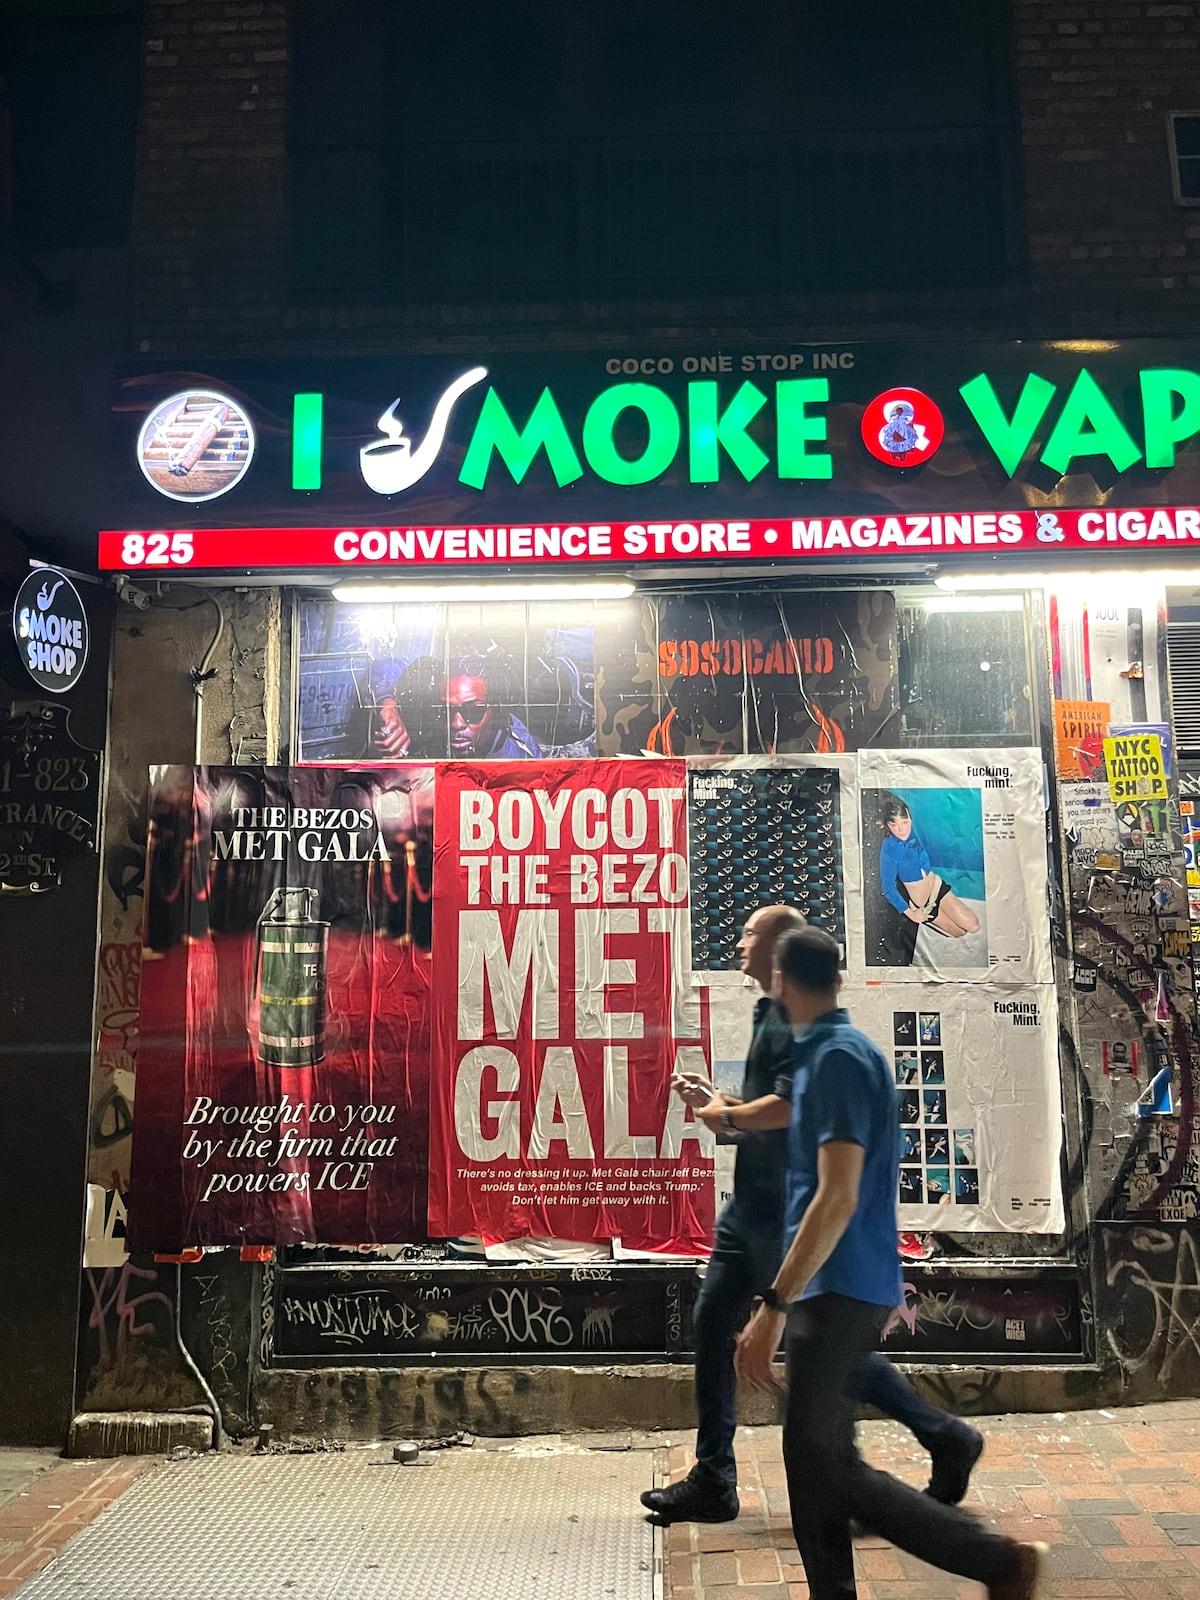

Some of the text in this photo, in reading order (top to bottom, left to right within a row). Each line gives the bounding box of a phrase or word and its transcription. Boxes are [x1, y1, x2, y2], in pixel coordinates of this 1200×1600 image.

[606, 352, 855, 374] COCO ONE STOP INC
[293, 393, 323, 490] I
[959, 367, 1200, 478] VAP
[121, 509, 1200, 565] 825 CONVENIENCE STORE MAGAZINES & CIGAR
[20, 608, 82, 649] SMOKE
[27, 641, 77, 675] SHOP
[1062, 710, 1102, 721] AMERICAN
[1063, 721, 1102, 738] SPIRIT
[1114, 739, 1151, 757] NYC
[1110, 756, 1160, 778] TATTOO
[232, 807, 374, 829] THE BEZOS
[460, 787, 684, 851] BOYCOT
[213, 830, 393, 862] MET GALA
[459, 853, 688, 905] THE BEZO
[457, 907, 701, 1040] MET
[1012, 1014, 1041, 1026] Mint.
[183, 1095, 397, 1133] Brought to you
[454, 1045, 715, 1162] GALA
[183, 1128, 399, 1167] by the firm that
[200, 1161, 374, 1202] powers ICE
[456, 1168, 495, 1178] There's
[498, 1170, 511, 1178] no
[514, 1168, 560, 1180] dressing
[562, 1168, 570, 1178] it
[572, 1170, 589, 1180] up.
[591, 1168, 612, 1177] Met
[615, 1168, 639, 1177] Gala
[641, 1168, 669, 1177] chair
[671, 1168, 690, 1177] Jeff
[480, 1182, 515, 1191] avoids
[517, 1182, 538, 1192] tax,
[540, 1182, 582, 1191] enables
[584, 1182, 603, 1191] ICE
[605, 1182, 627, 1191] and
[629, 1181, 662, 1191] backs
[511, 1195, 669, 1207] Don't let him get away with it.
